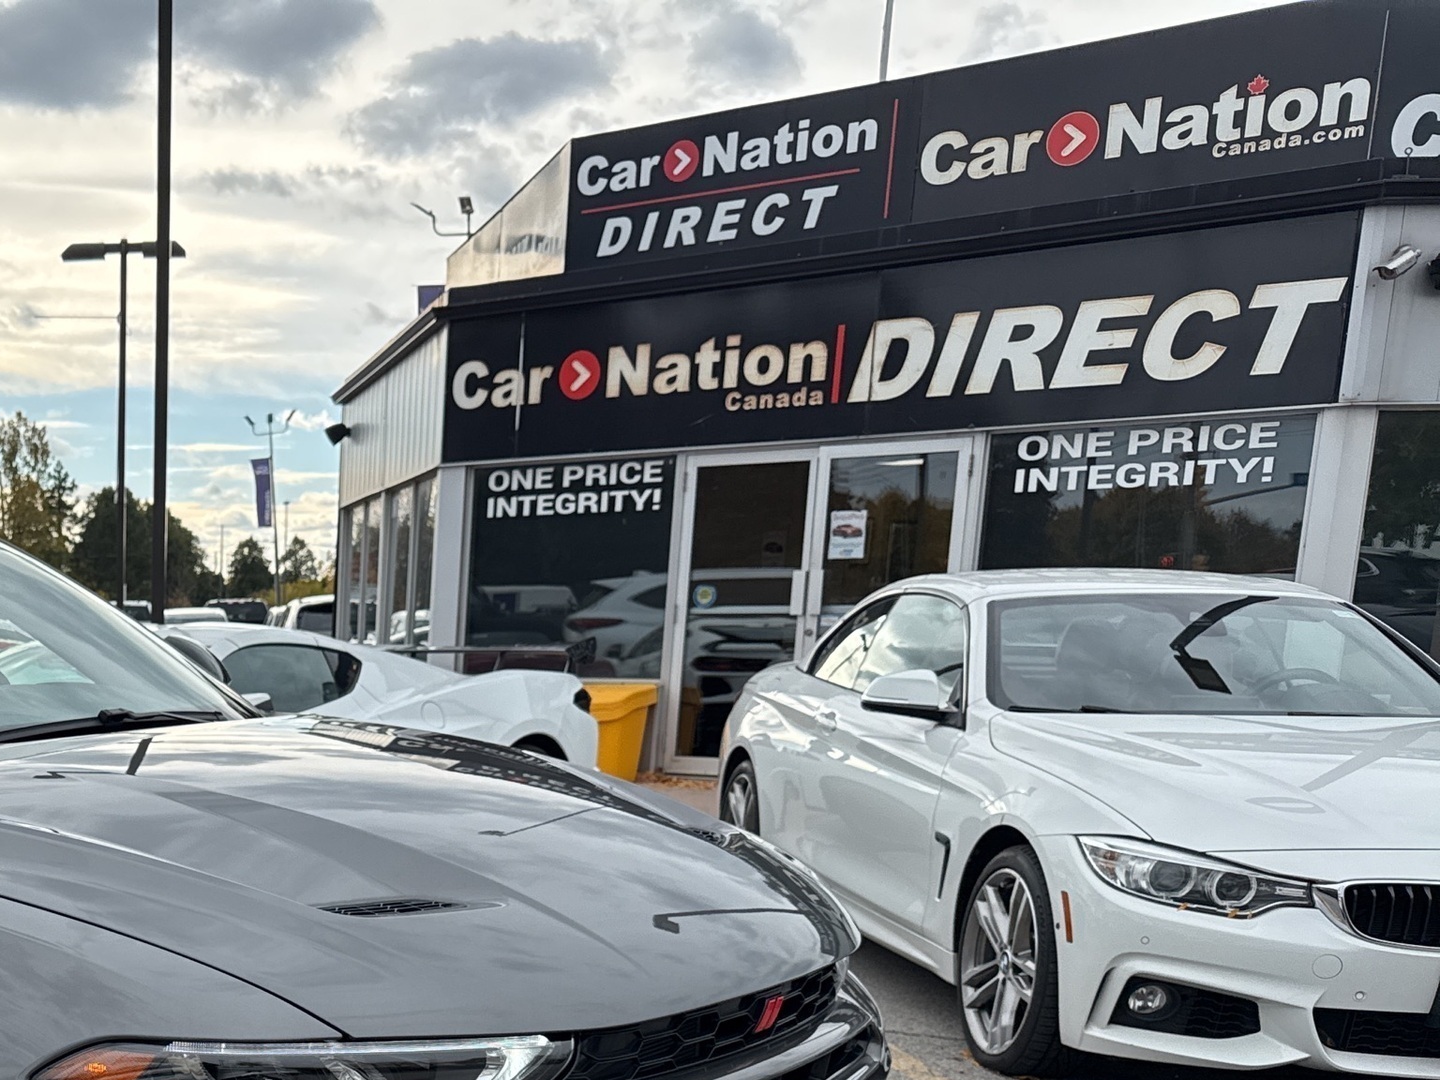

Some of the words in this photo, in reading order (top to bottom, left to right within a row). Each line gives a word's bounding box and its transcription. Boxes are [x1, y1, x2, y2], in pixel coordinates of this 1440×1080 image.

[920, 129, 1044, 186] Car
[1104, 76, 1371, 160] Nation
[1212, 122, 1366, 159] Canada.com
[577, 154, 661, 196] Car
[702, 118, 879, 177] Nation
[596, 184, 839, 258] DIRECT
[452, 360, 554, 410] Car
[605, 334, 829, 399] Nation
[846, 276, 1349, 404] DIRECT
[725, 386, 824, 411] Canada
[1017, 430, 1115, 462] ONE
[1127, 421, 1281, 456] PRICE
[488, 466, 554, 492] ONE
[562, 460, 664, 489] PRICE
[1014, 456, 1274, 493] INTEGRITY!
[486, 488, 661, 519] INTEGRITY!
